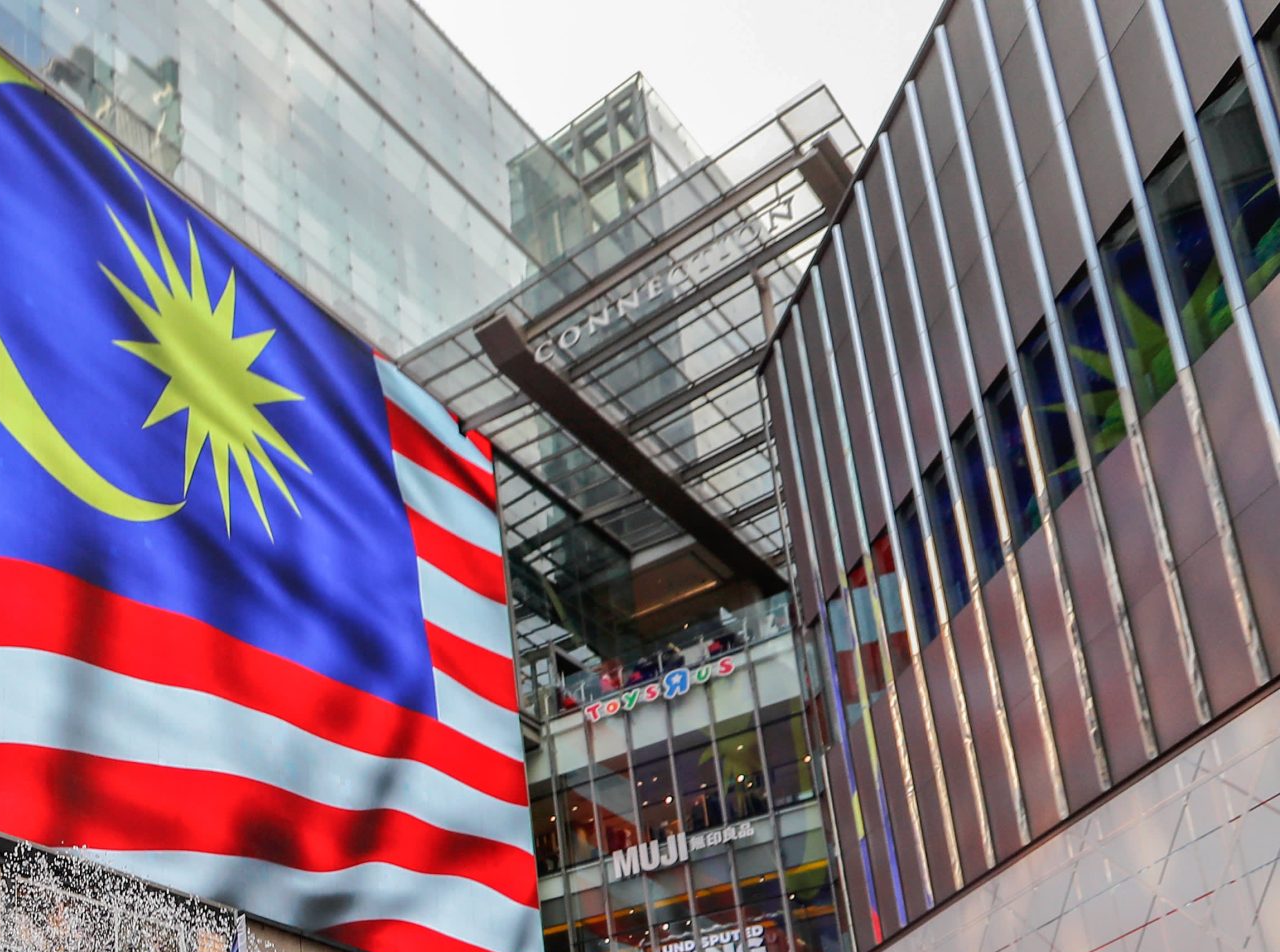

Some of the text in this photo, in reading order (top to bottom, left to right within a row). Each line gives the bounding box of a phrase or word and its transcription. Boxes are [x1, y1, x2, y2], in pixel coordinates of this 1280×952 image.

[533, 194, 796, 365] CONNECTION
[585, 683, 661, 721] TOYS
[696, 656, 736, 683] US
[612, 831, 689, 880] MUJI
[689, 822, 755, 852] 無印良品
